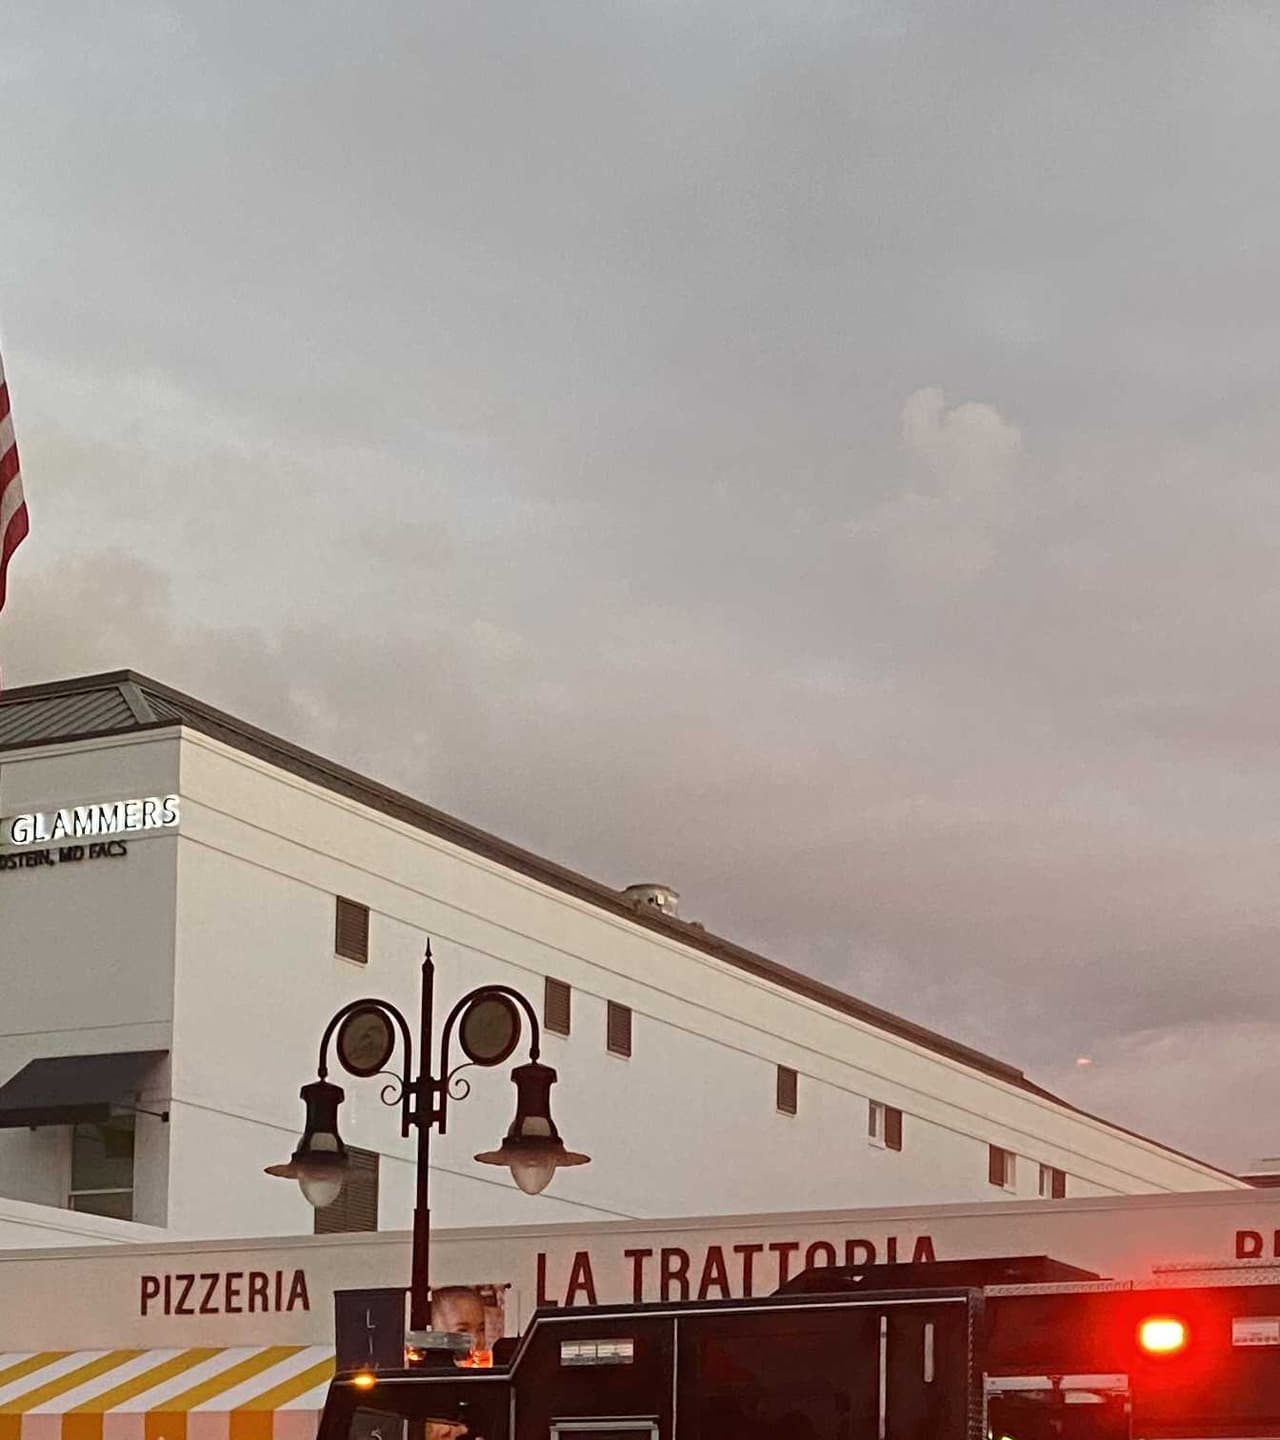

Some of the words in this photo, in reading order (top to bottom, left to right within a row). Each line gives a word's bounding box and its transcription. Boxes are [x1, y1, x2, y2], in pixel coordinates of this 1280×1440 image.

[11, 797, 179, 845] GLAMMERS
[59, 845, 85, 863] MD
[89, 840, 127, 859] FACS
[140, 1269, 310, 1316] PIZZERIA
[536, 1251, 597, 1307] LA
[624, 1235, 937, 1305] TRATTORIA
